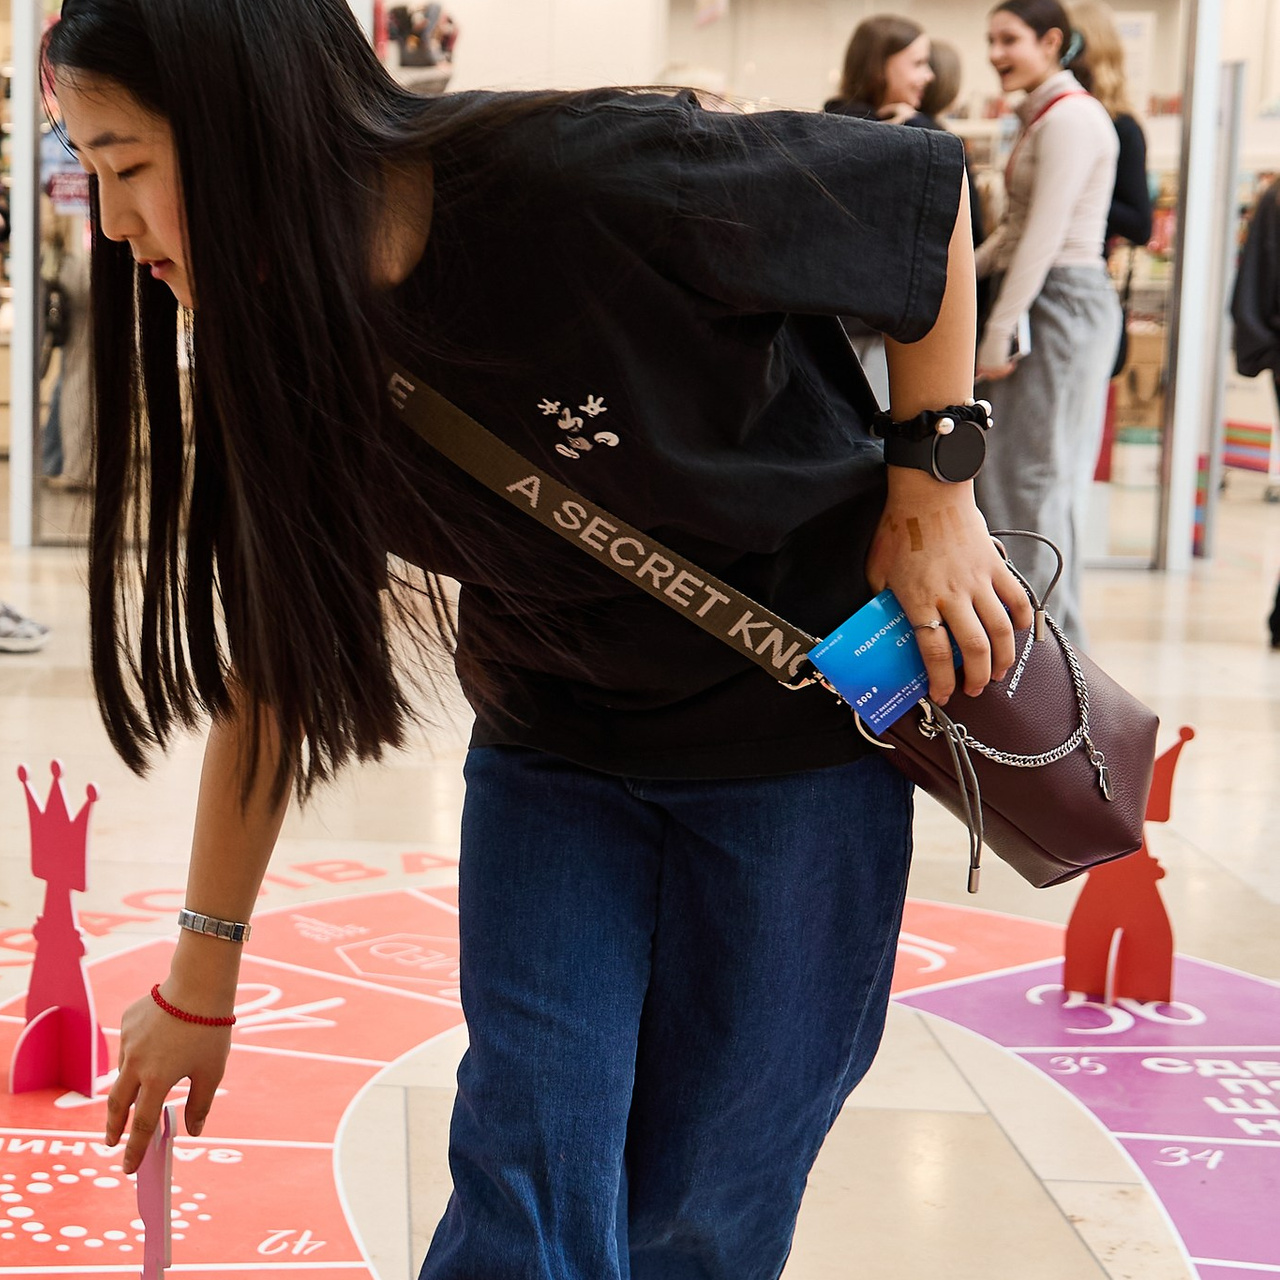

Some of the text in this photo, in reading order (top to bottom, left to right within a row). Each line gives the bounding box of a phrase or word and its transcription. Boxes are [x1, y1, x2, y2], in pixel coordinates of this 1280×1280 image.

[506, 474, 542, 509] A
[552, 499, 731, 619] SECRET
[1009, 659, 1026, 691] SECRET
[856, 691, 873, 707] 500
[1006, 690, 1015, 699] A
[1049, 1055, 1108, 1075] 35
[1152, 1145, 1225, 1170] 34
[256, 1229, 328, 1256] 42
